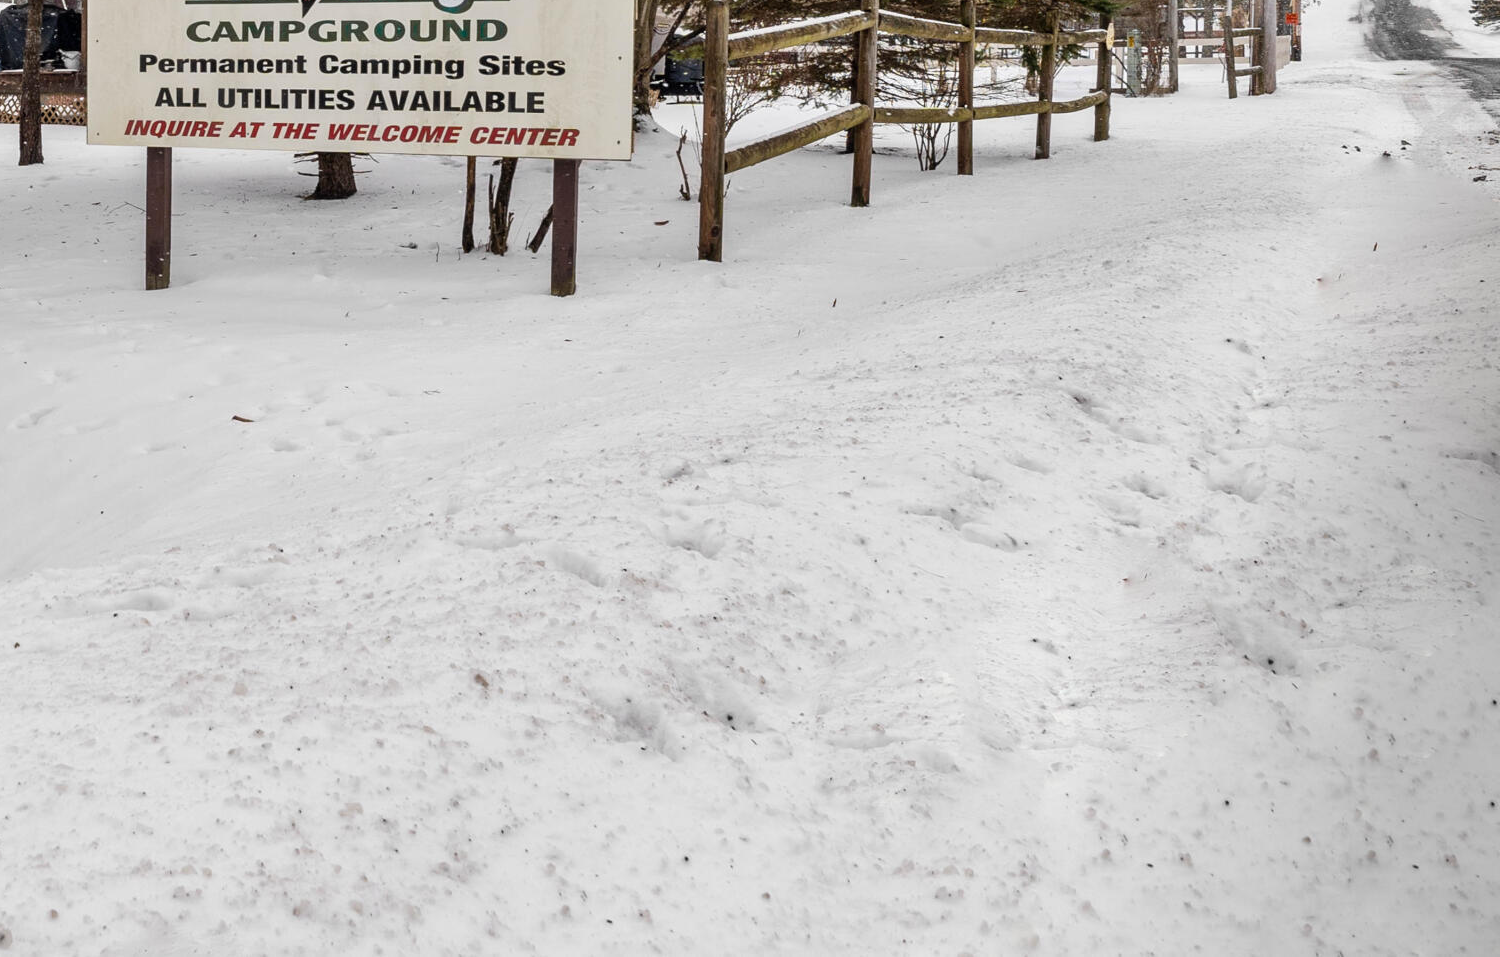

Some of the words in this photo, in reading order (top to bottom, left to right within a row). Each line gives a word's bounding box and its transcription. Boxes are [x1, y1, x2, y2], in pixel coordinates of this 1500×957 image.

[185, 18, 509, 43] CAMPGROUND
[138, 54, 308, 75] Permanent
[318, 54, 466, 81] Camping
[477, 54, 567, 78] Sites
[154, 87, 208, 109] ALL
[217, 87, 356, 112] UTILITIES
[365, 89, 546, 115] AVAILABLE
[123, 118, 225, 139] INQUIRE
[228, 120, 266, 139] AT
[272, 122, 320, 141] THE
[326, 123, 463, 145] WELCOME
[469, 126, 582, 148] CENTER
